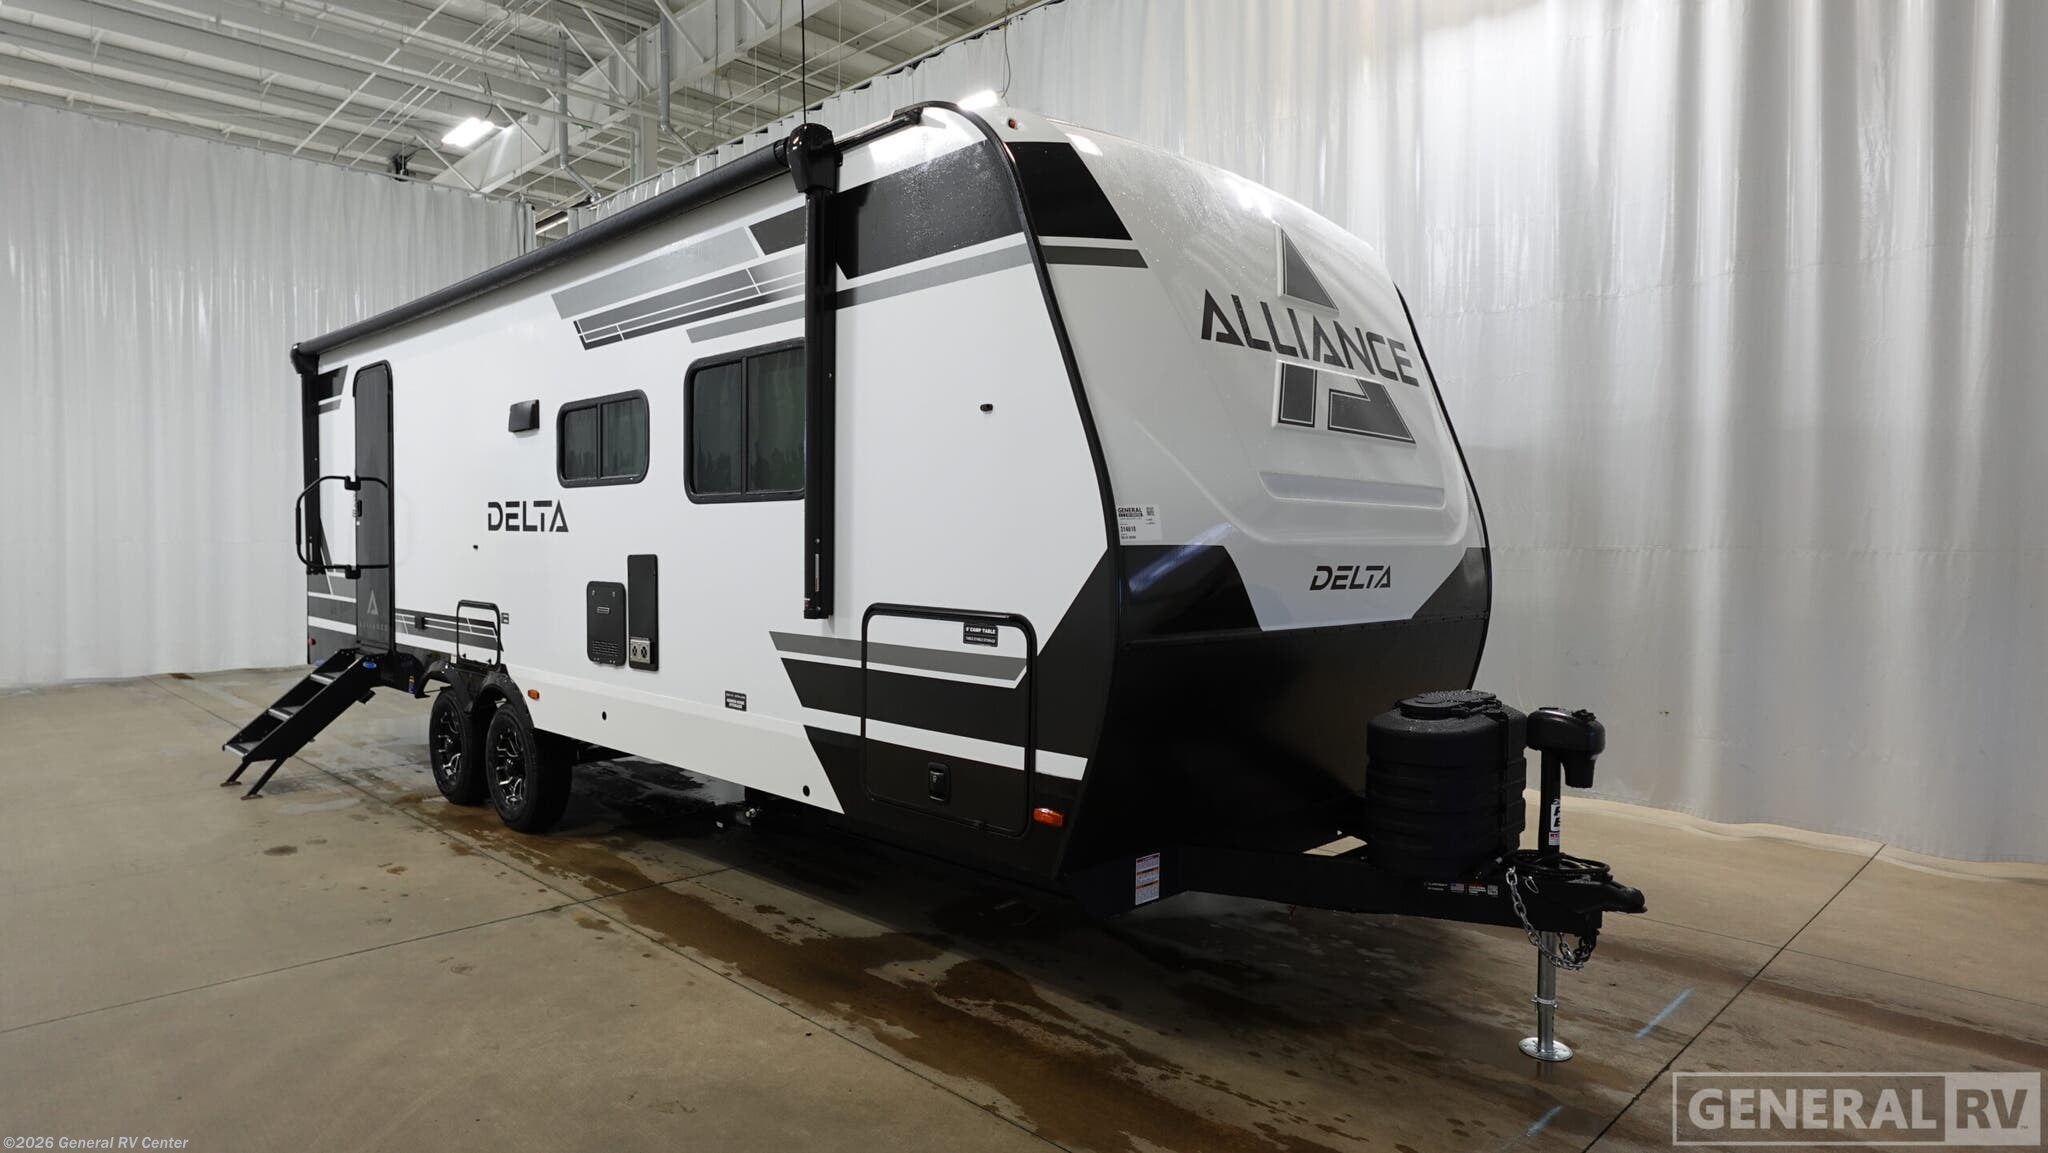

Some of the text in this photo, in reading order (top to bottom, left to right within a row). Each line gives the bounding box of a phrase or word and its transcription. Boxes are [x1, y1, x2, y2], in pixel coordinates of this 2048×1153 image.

[1201, 289, 1419, 387] ALLIANCE
[488, 500, 569, 532] DELTA
[1310, 565, 1391, 591] DELTA
